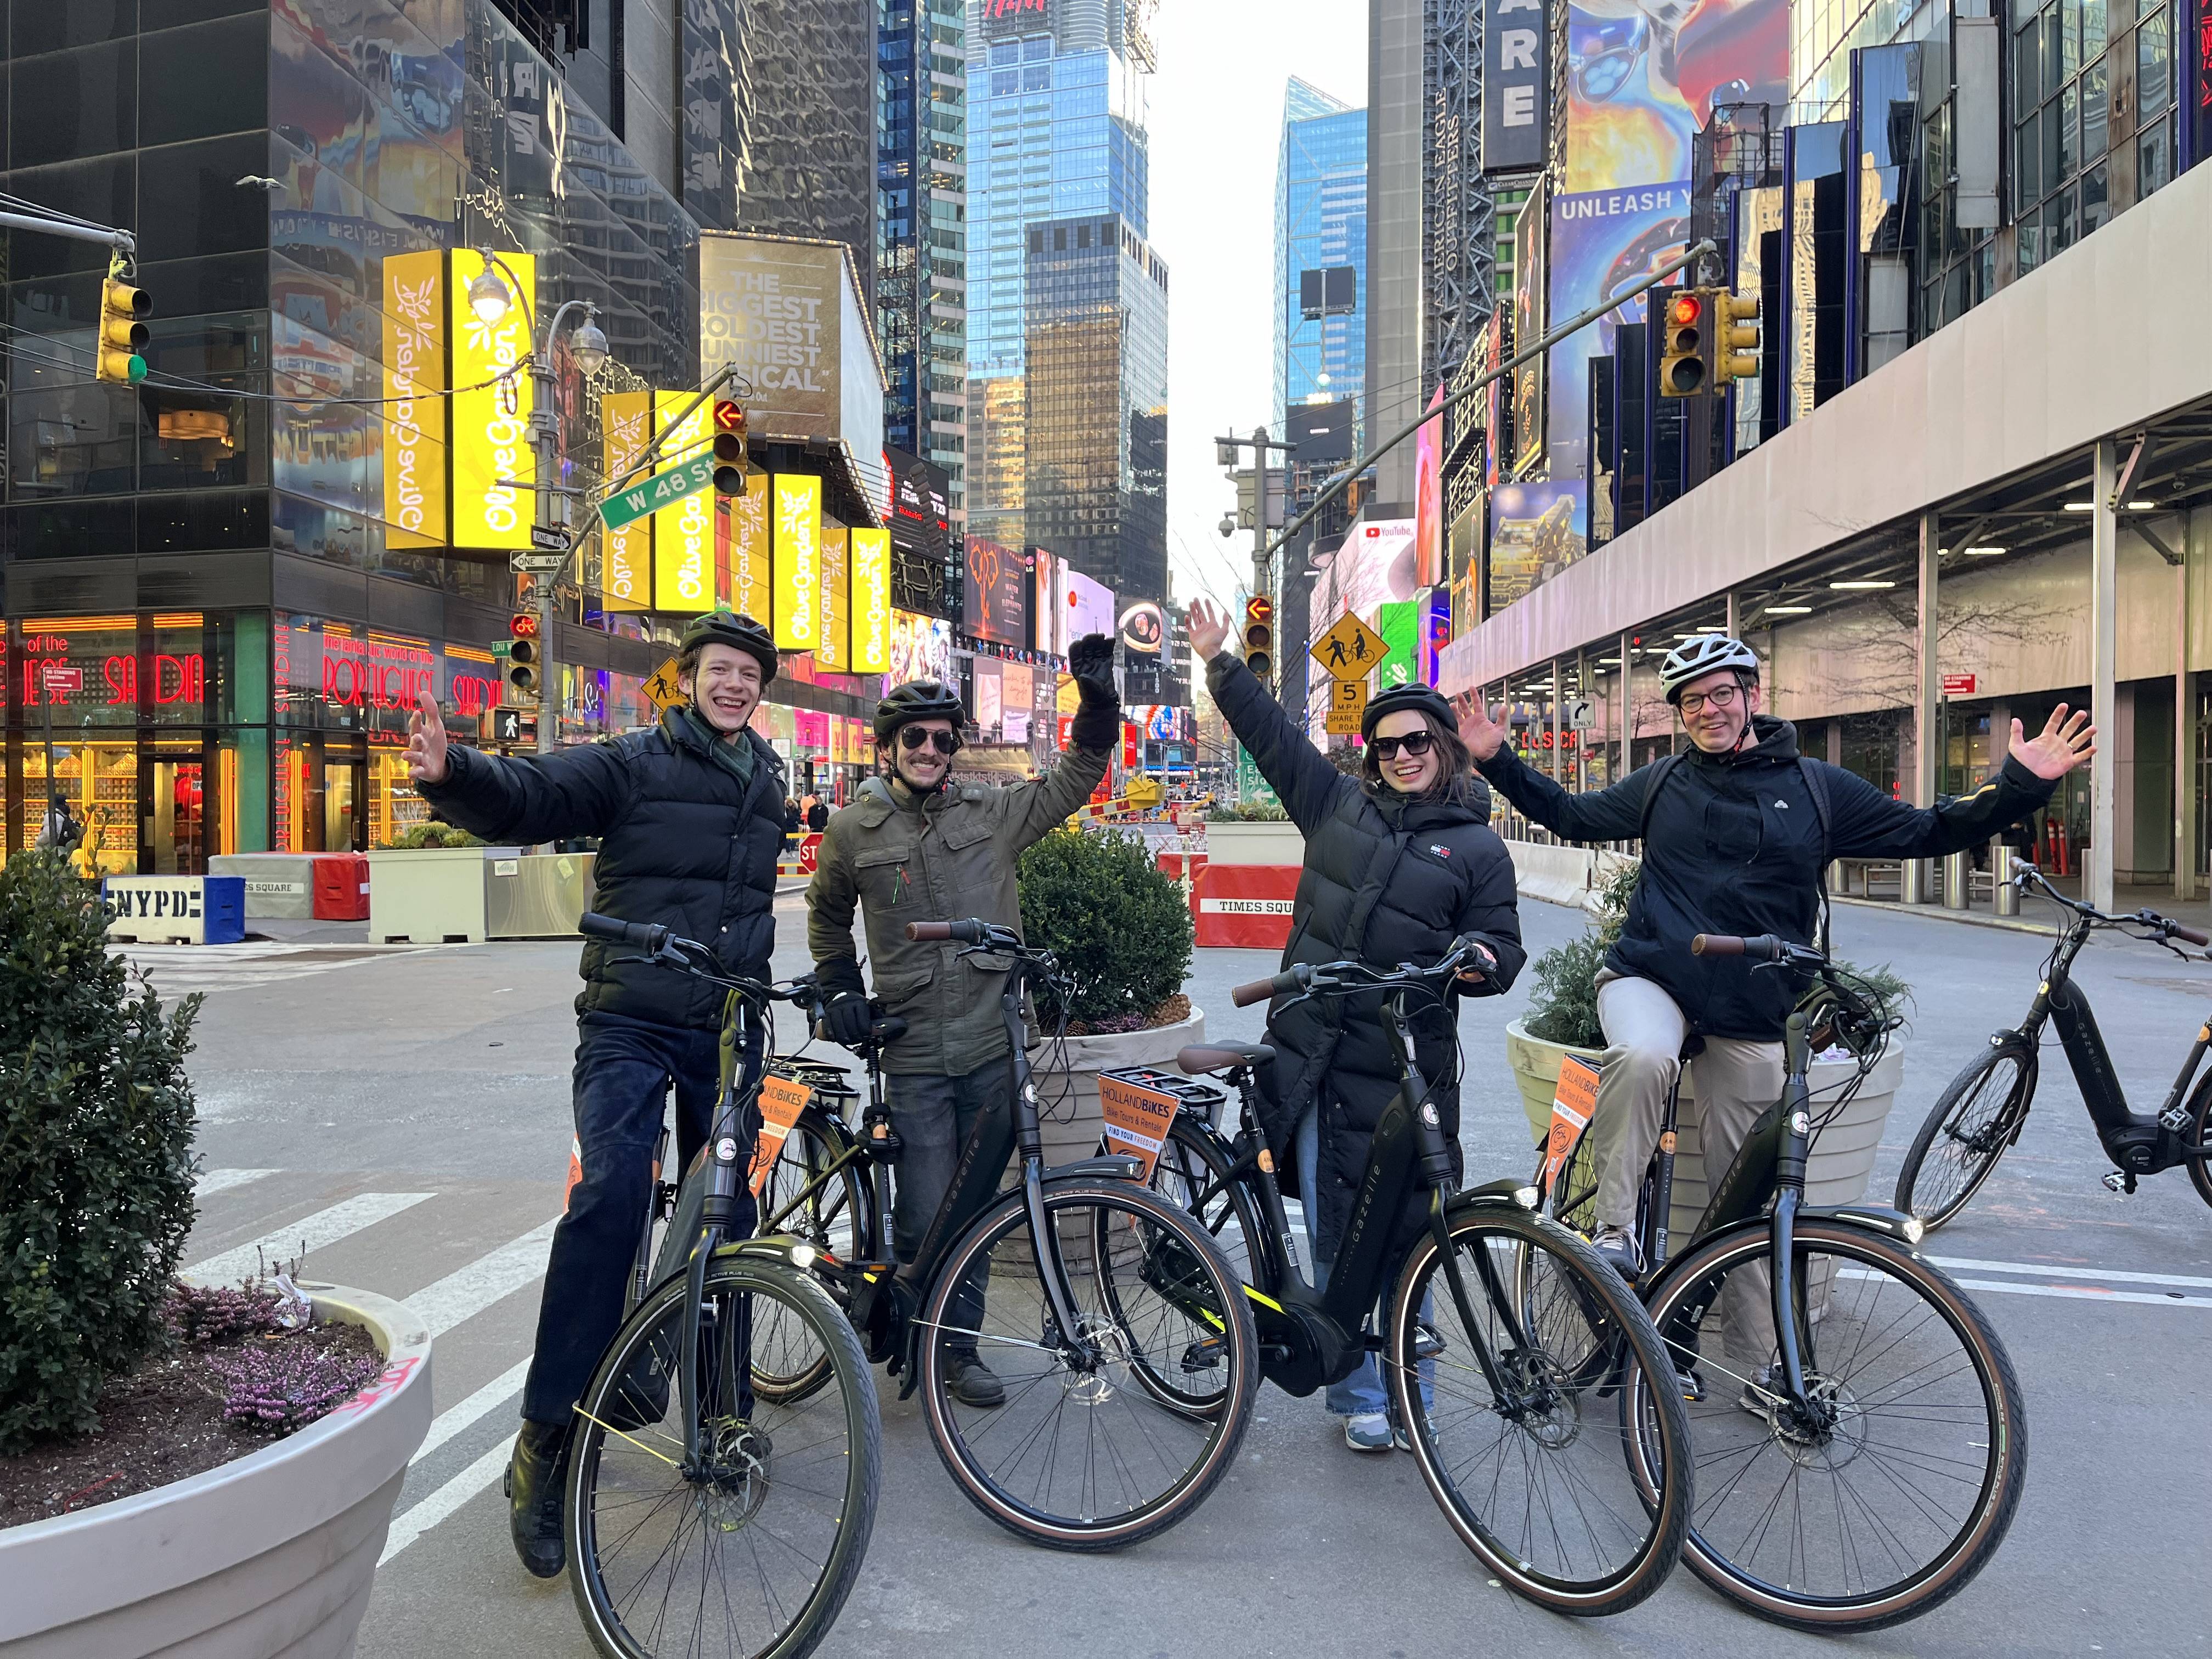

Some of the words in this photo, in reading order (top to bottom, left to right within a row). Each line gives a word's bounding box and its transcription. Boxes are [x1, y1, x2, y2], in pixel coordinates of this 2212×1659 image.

[1435, 87, 1447, 167] EAGLE
[1446, 114, 1459, 270] OUTFITTERS
[1562, 192, 1671, 219] UNLEASH
[1434, 173, 1446, 307] AMERICAN
[702, 338, 821, 366] UNNIEST
[756, 392, 768, 402] Out
[485, 448, 517, 532] Olive
[625, 490, 646, 512] W
[655, 473, 687, 499] 48
[691, 458, 714, 482] St
[536, 533, 548, 543] ONE
[553, 537, 565, 547] WAY
[1381, 526, 1410, 537] YouTube
[518, 557, 535, 566] ONE
[545, 557, 563, 565] WAY
[793, 516, 815, 589] Garden
[678, 536, 702, 599] Olive
[867, 562, 885, 622] Garden
[1005, 583, 1019, 594] WATER
[791, 589, 810, 640] Olive
[1002, 599, 1022, 612] ELEPHANTS
[28, 636, 42, 652] of
[46, 636, 67, 652] the
[383, 645, 407, 662] world
[409, 649, 420, 663] of
[420, 650, 434, 665] the
[492, 642, 505, 652] LOU
[866, 623, 882, 664] Olive
[1343, 685, 1356, 700] 5
[802, 845, 817, 860] ST
[116, 890, 187, 917] NYPD
[1220, 901, 1262, 912] TIMES
[774, 1107, 792, 1120] Rentals
[1107, 1106, 1118, 1118] Bike
[1120, 1110, 1133, 1124] Tours
[1135, 1116, 1139, 1125] &
[1141, 1118, 1162, 1132] Rentals
[765, 1124, 785, 1136] FREEDOM
[1108, 1126, 1120, 1136] FIND
[1120, 1130, 1133, 1141] YOUR
[1134, 1135, 1157, 1149] FREEDOM
[1353, 1165, 1381, 1242] Gazelle
